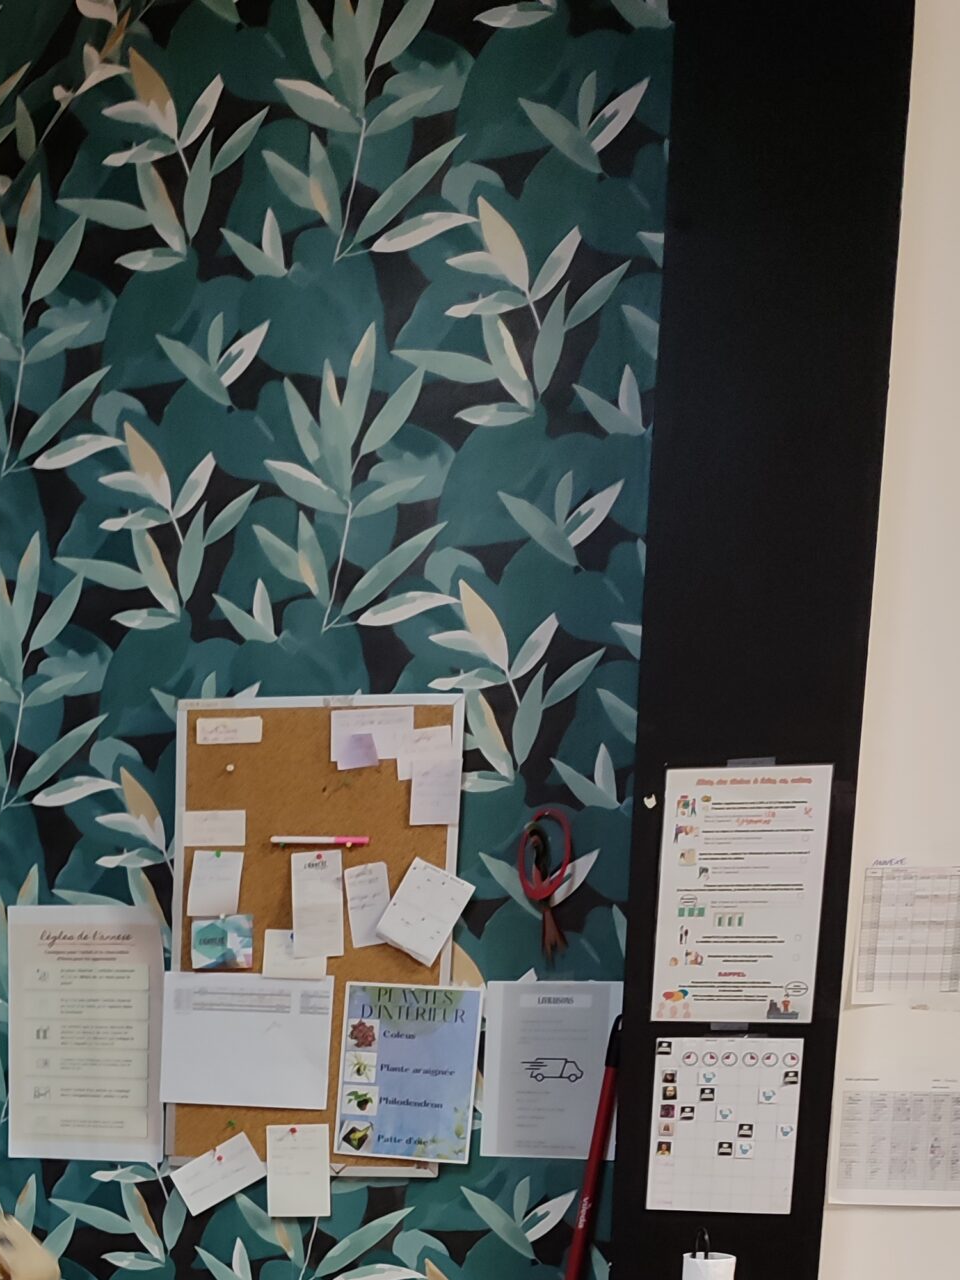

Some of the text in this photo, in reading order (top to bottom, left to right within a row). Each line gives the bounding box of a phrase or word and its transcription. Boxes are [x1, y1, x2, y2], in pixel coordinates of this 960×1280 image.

[377, 988, 454, 1005] PLANTES
[361, 1003, 466, 1024] D'INTÉRIEUR
[383, 1029, 416, 1040] Coleus
[380, 1063, 456, 1077] Plante araignée
[379, 1096, 444, 1110] Philodendron
[377, 1134, 402, 1144] Patte
